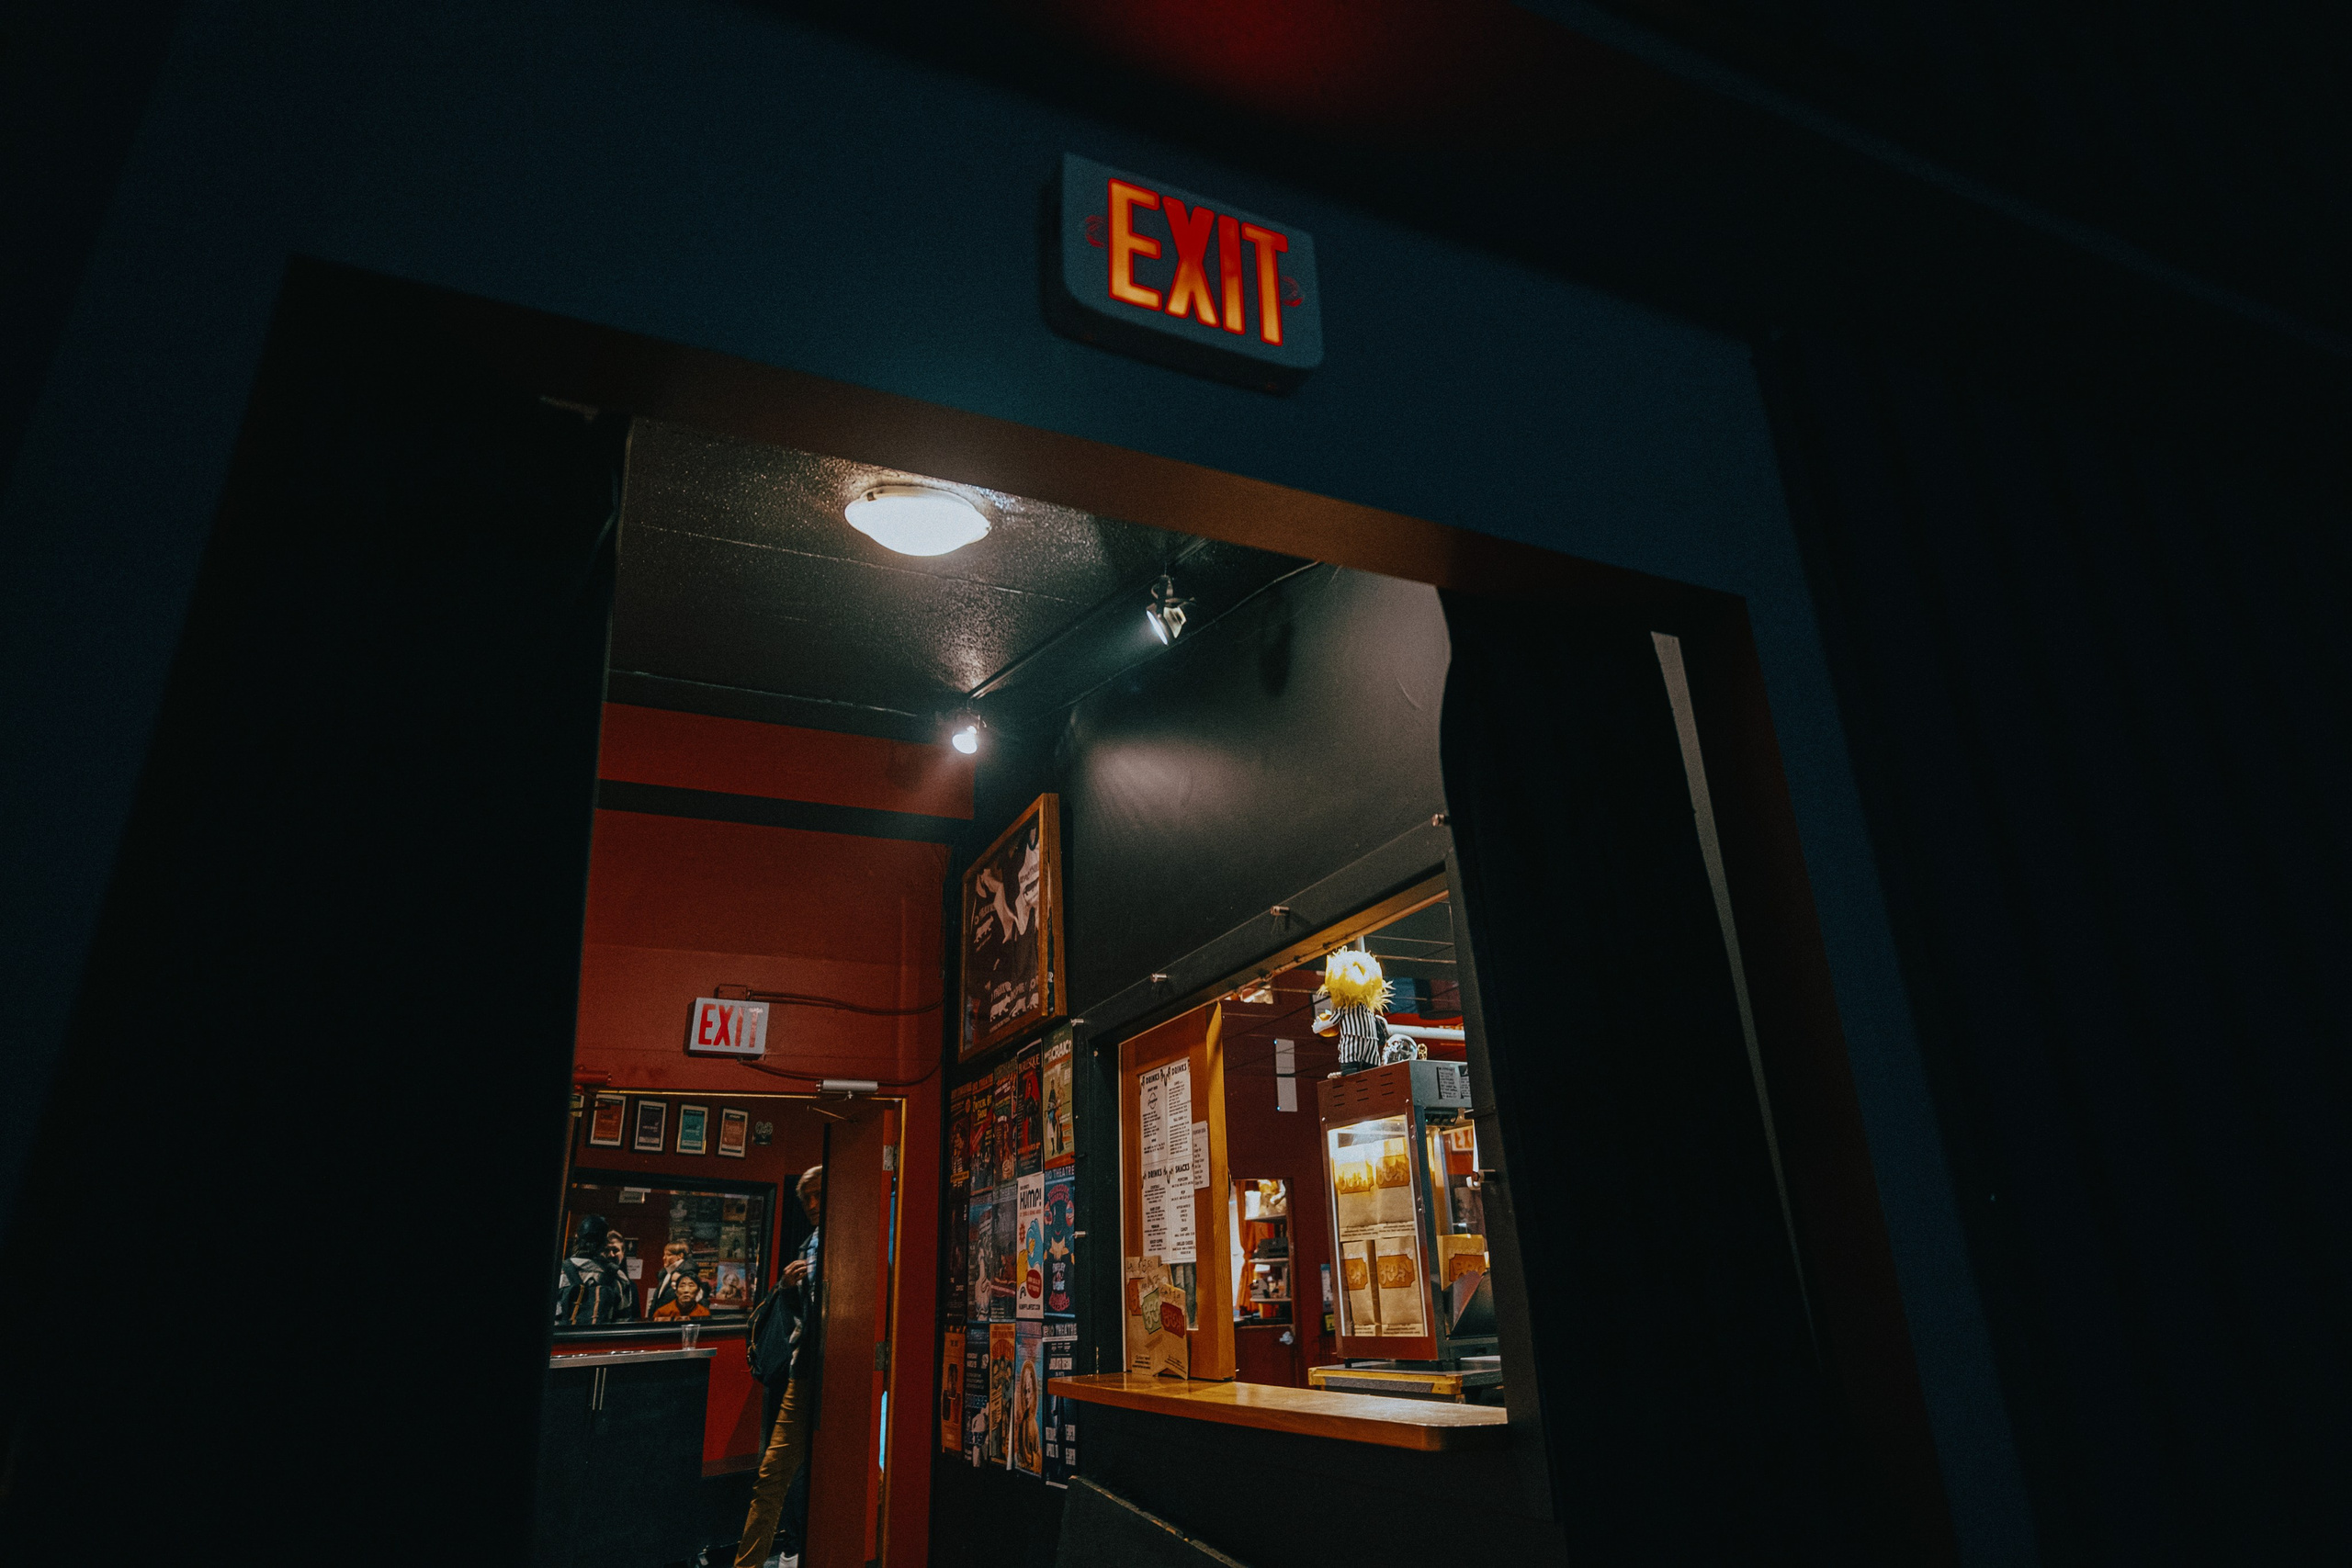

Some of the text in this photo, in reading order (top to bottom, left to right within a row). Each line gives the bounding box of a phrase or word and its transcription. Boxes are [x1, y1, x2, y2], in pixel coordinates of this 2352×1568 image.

[1108, 177, 1288, 346] EXIT
[698, 1003, 763, 1048] EXIT
[1051, 1039, 1072, 1060] CRAIC?
[1171, 1063, 1187, 1076] DRINKS
[1146, 1073, 1159, 1085] DRINKS
[1054, 1166, 1075, 1179] THEATRE
[1148, 1168, 1162, 1179] DRINKS
[1175, 1163, 1190, 1174] SNACKS
[1020, 1188, 1042, 1210] HUMP!
[1055, 1323, 1078, 1337] THEATRE
